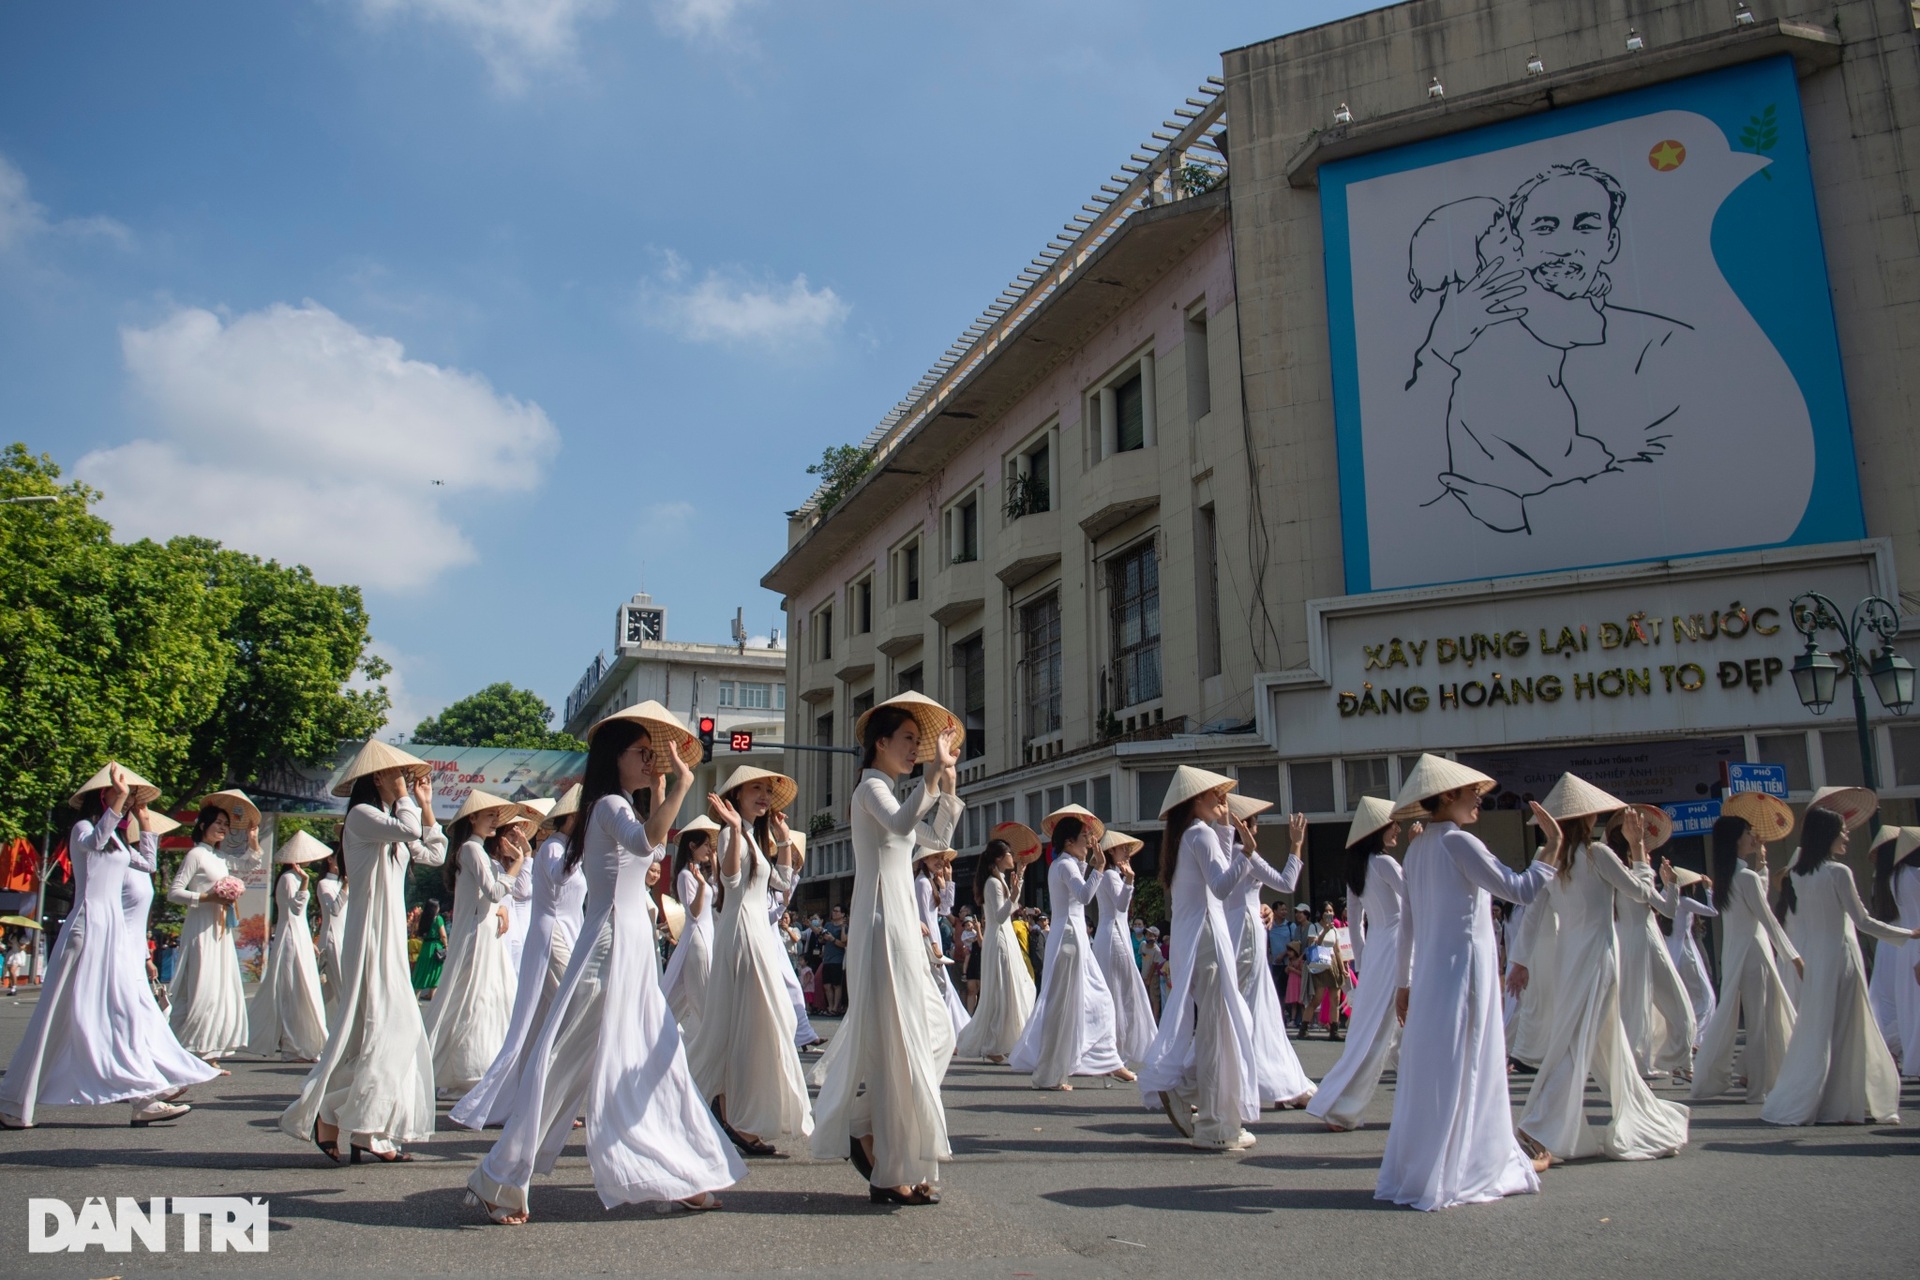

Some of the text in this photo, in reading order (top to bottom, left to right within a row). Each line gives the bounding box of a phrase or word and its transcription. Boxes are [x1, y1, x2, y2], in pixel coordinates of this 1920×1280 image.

[1363, 637, 1428, 670] XÂY
[1436, 629, 1530, 668] DỰNG
[1539, 624, 1588, 658] LẠI
[1598, 610, 1662, 649] ĐẤT
[1672, 600, 1780, 644] NƯỚC
[1337, 681, 1430, 718] ĐÀNG
[1438, 671, 1564, 710] HOÀNG
[1573, 666, 1651, 700] HƠN
[1659, 662, 1706, 693] TO
[1716, 656, 1783, 694] ĐẸP
[732, 734, 750, 749] 22
[458, 773, 485, 783] 2023
[1753, 767, 1771, 776] PHỐ
[1734, 777, 1762, 792] TRÀNG
